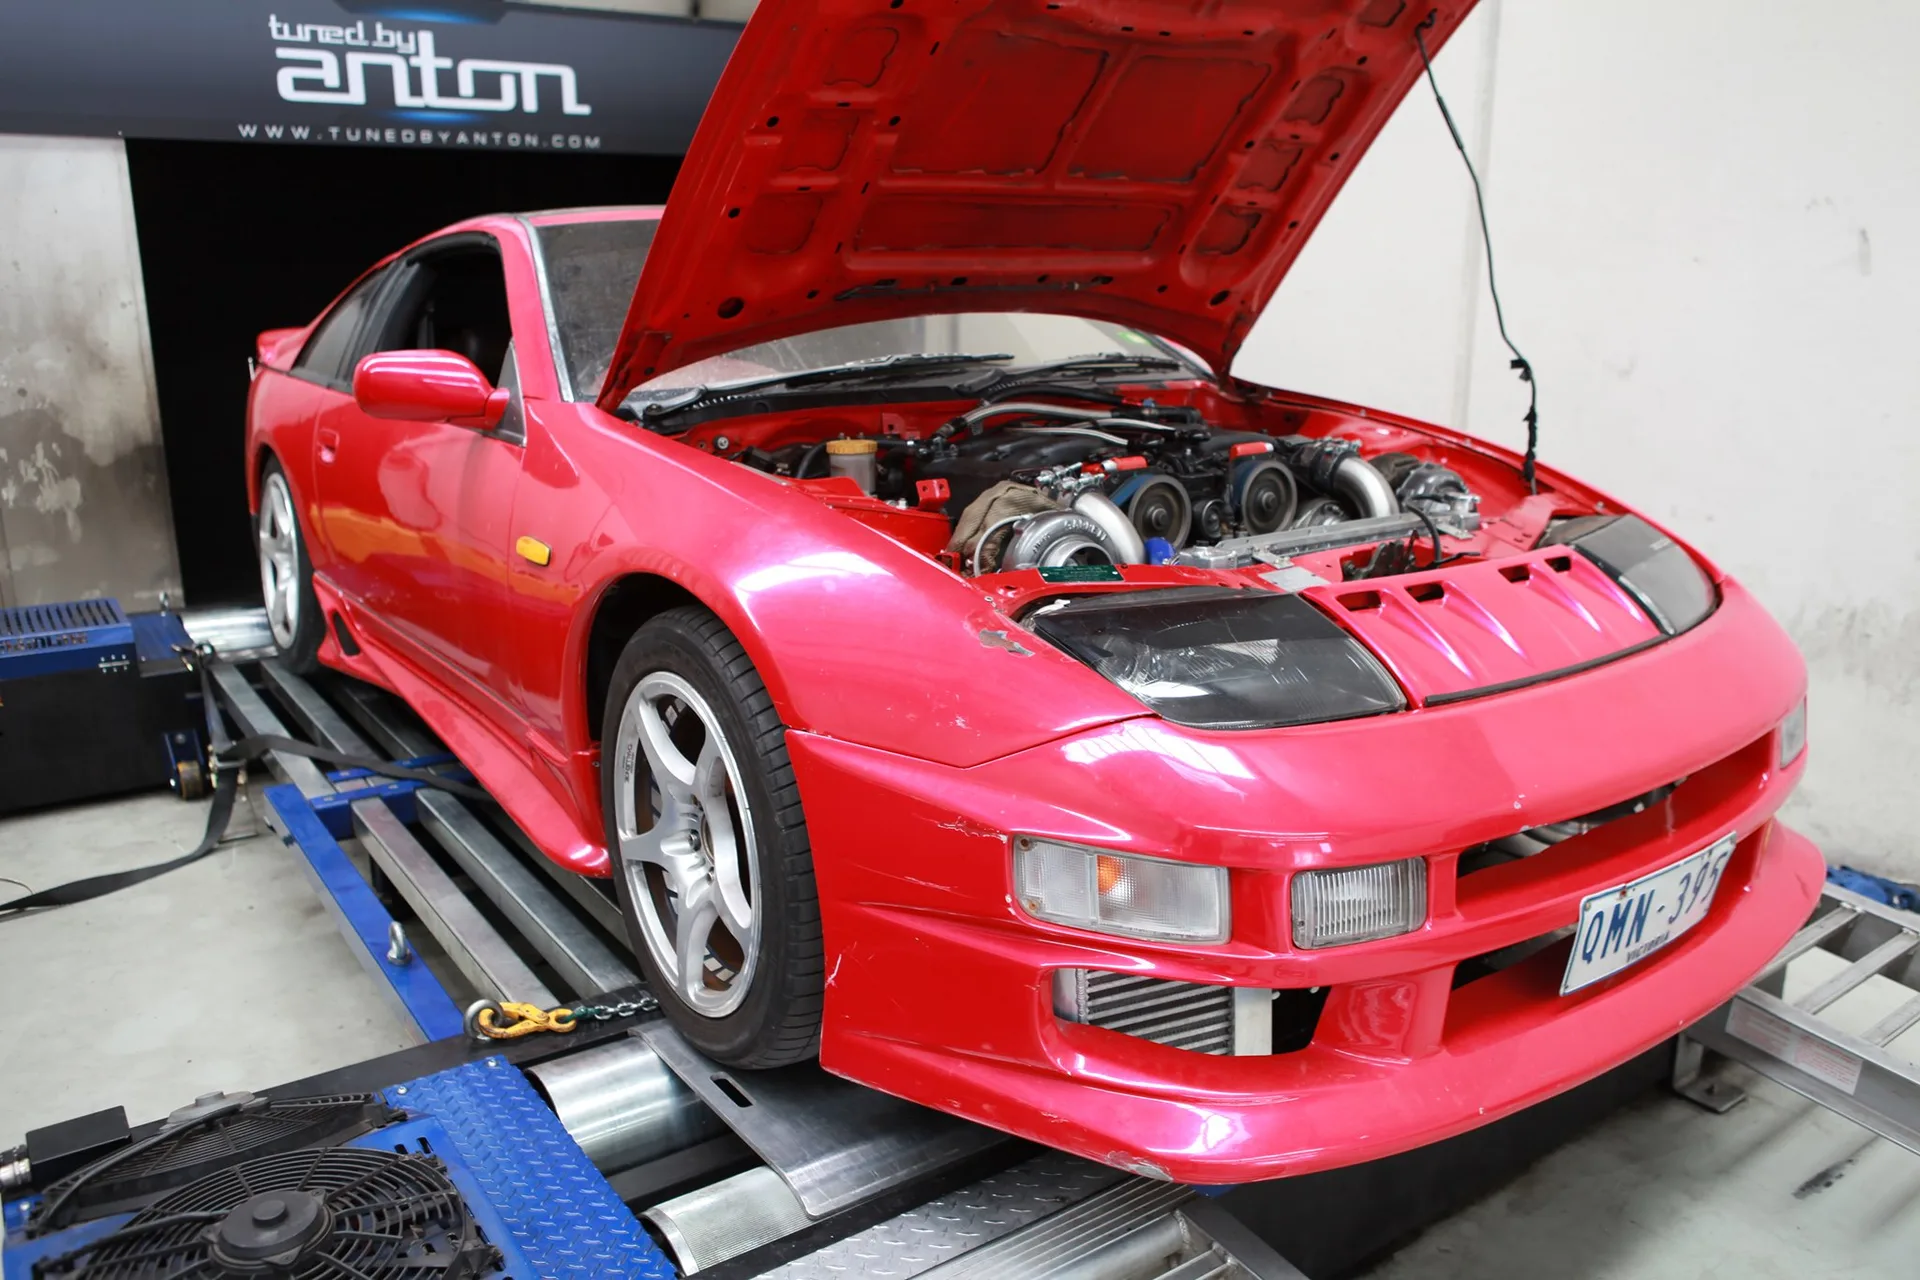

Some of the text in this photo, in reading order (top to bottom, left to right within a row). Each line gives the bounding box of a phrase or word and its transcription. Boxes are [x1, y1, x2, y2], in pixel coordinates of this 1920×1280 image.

[268, 14, 416, 53] tuned by
[275, 31, 592, 115] anton
